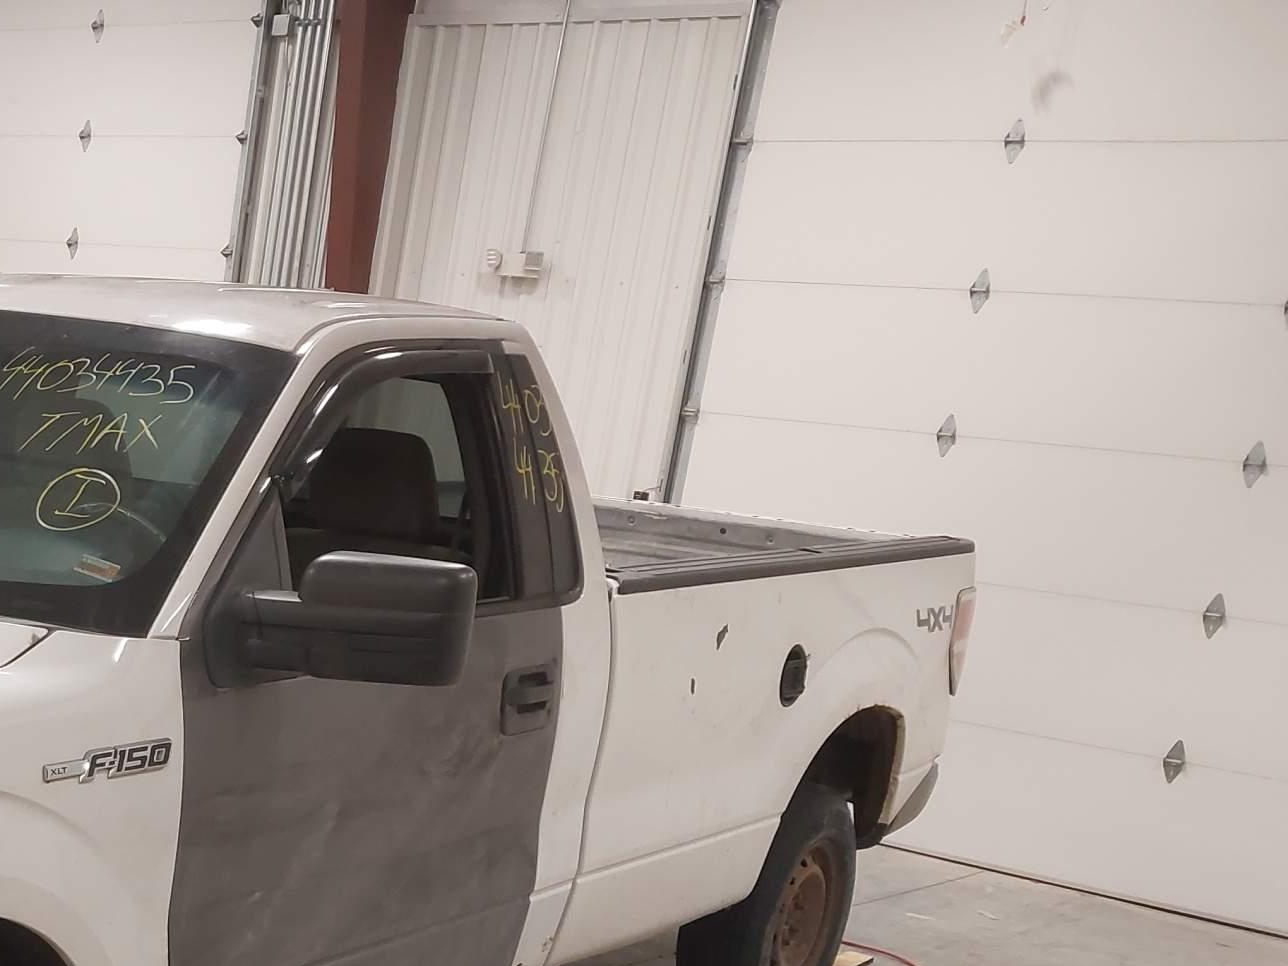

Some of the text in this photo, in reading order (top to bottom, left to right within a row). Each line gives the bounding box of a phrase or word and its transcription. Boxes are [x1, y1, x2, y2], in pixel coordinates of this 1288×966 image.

[18, 411, 162, 455] TMAX
[50, 742, 172, 778] XLT F-150
